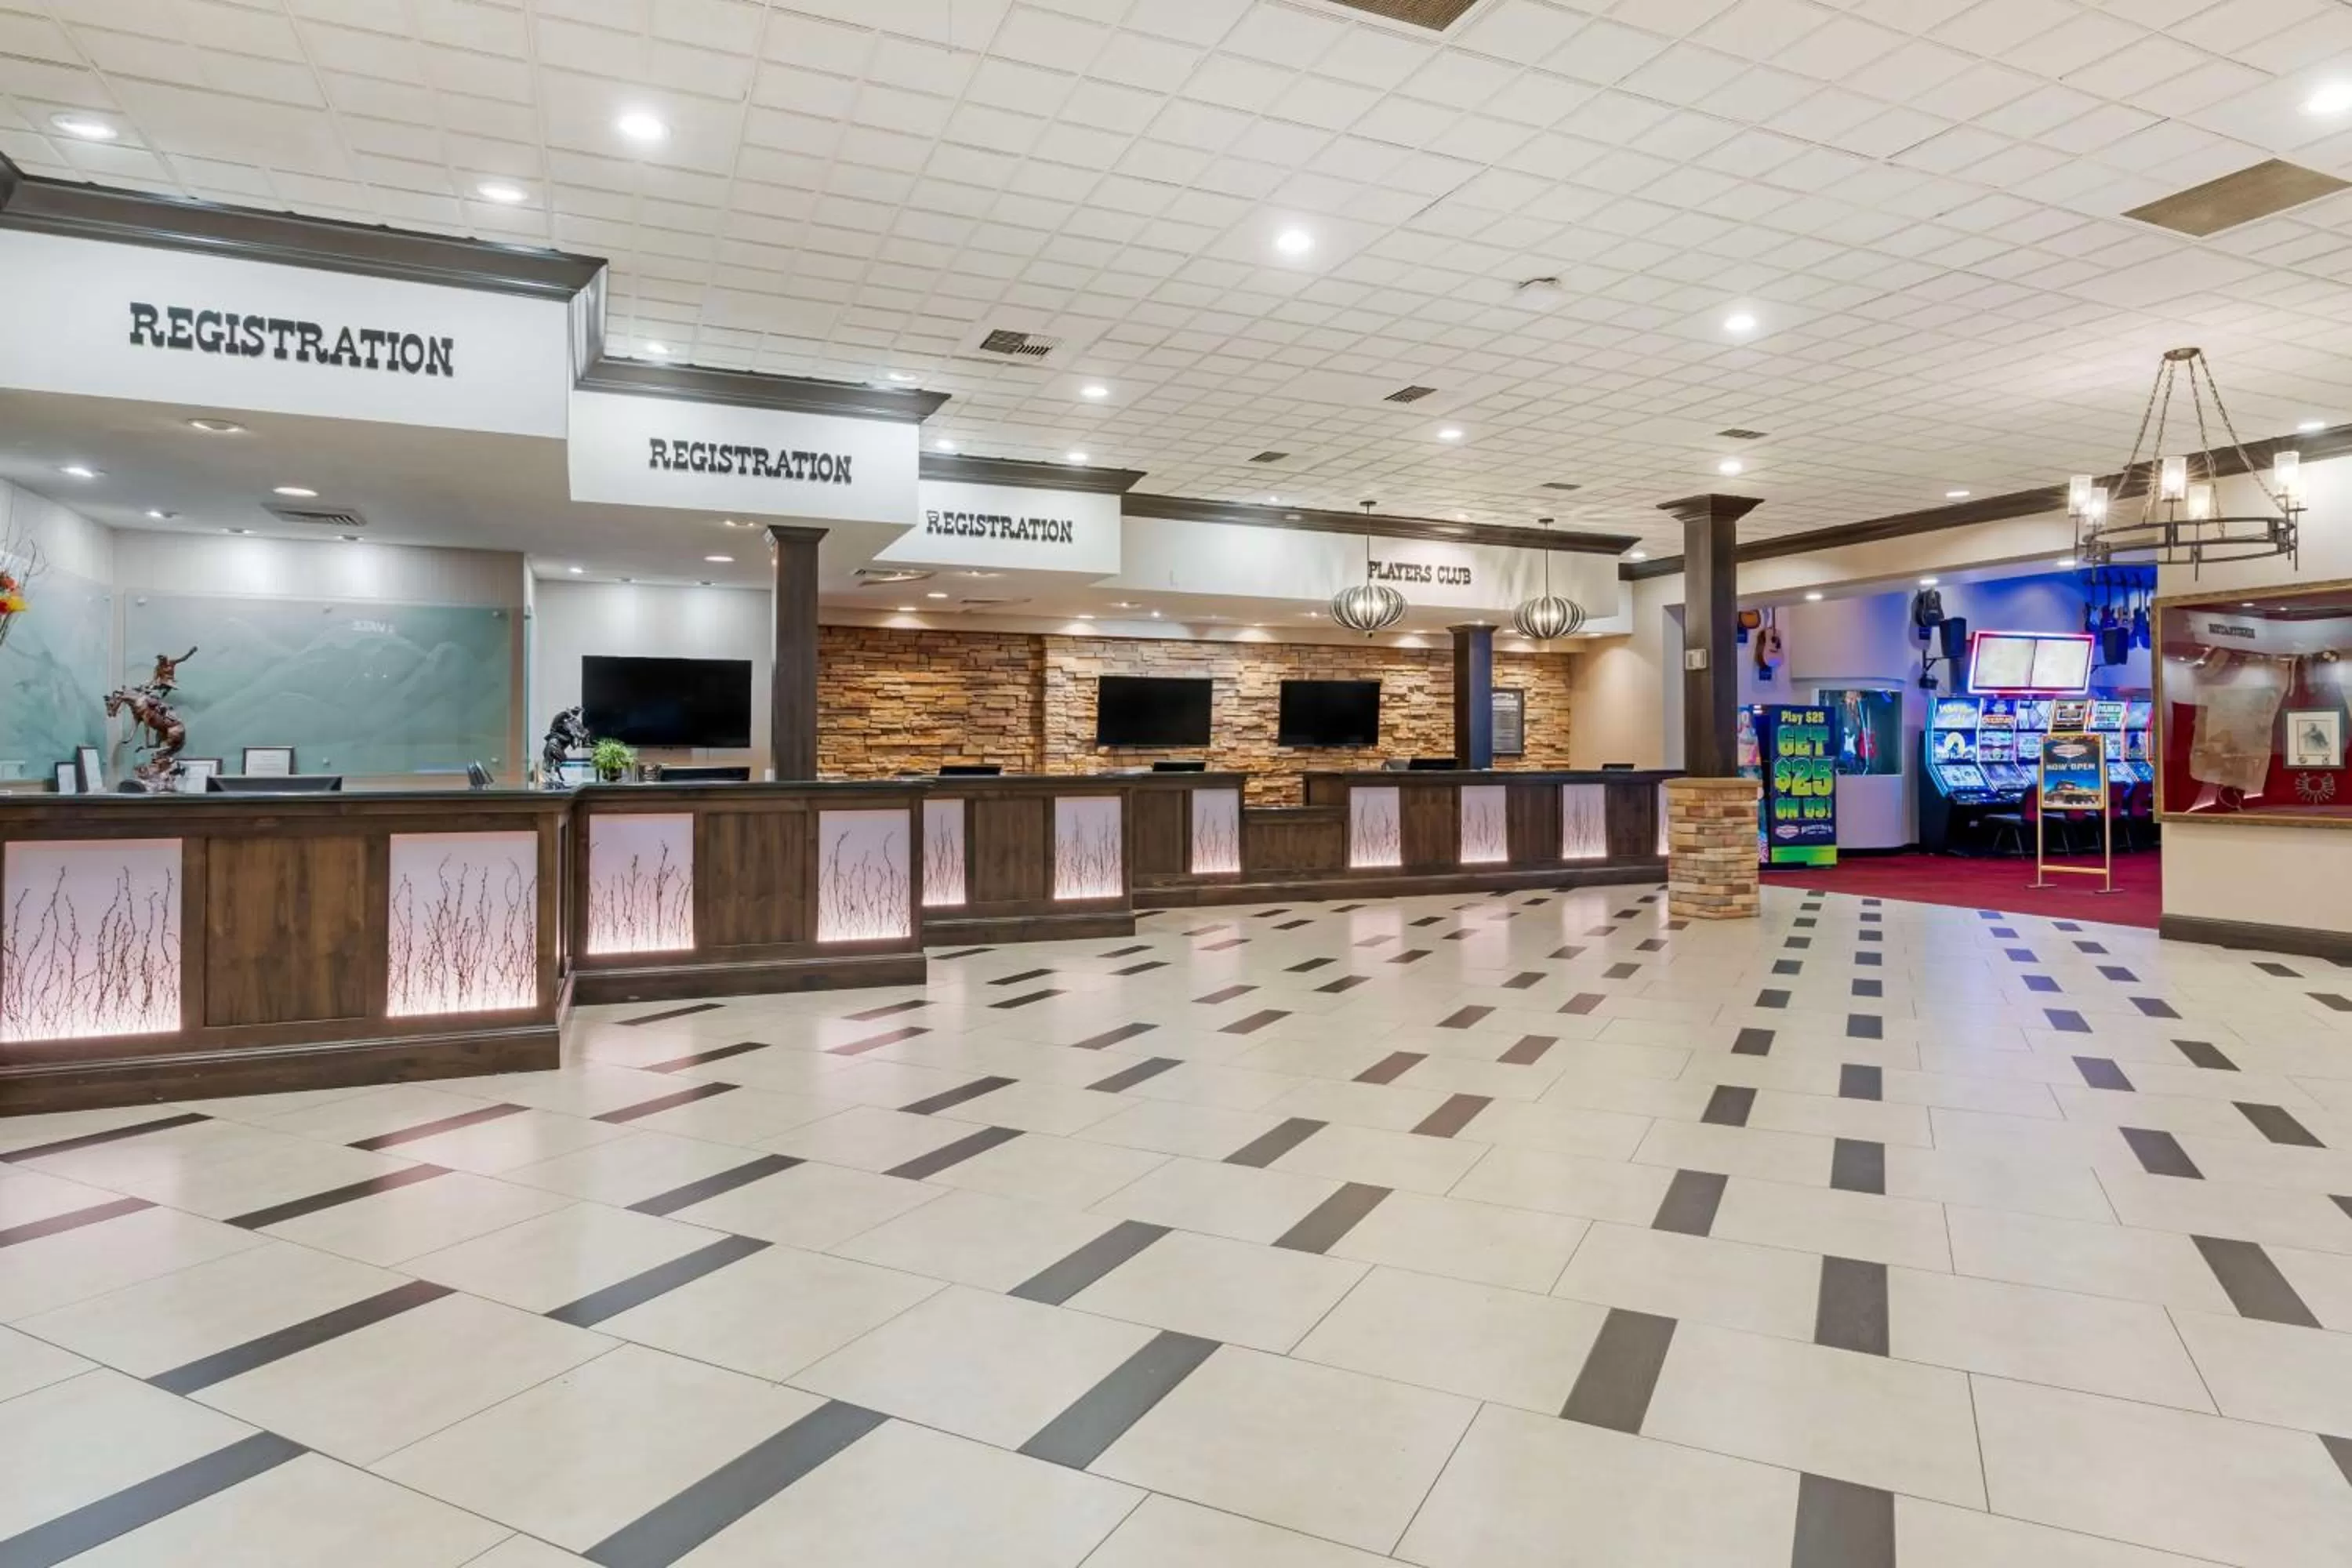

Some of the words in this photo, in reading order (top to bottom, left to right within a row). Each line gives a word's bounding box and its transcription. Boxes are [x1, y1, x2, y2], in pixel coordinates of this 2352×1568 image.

[129, 302, 454, 377] REGISTRATION
[649, 437, 852, 485] REGISTRATION
[926, 510, 1073, 543] REGISTRATION
[1368, 561, 1432, 583] PLAYERS
[1437, 565, 1471, 585] CLUB
[1781, 711, 1803, 724] Play
[1806, 711, 1825, 724] $25
[1777, 724, 1829, 757] GET
[1775, 757, 1833, 797] $25
[1776, 797, 1798, 819] ON
[1804, 797, 1832, 818] US!
